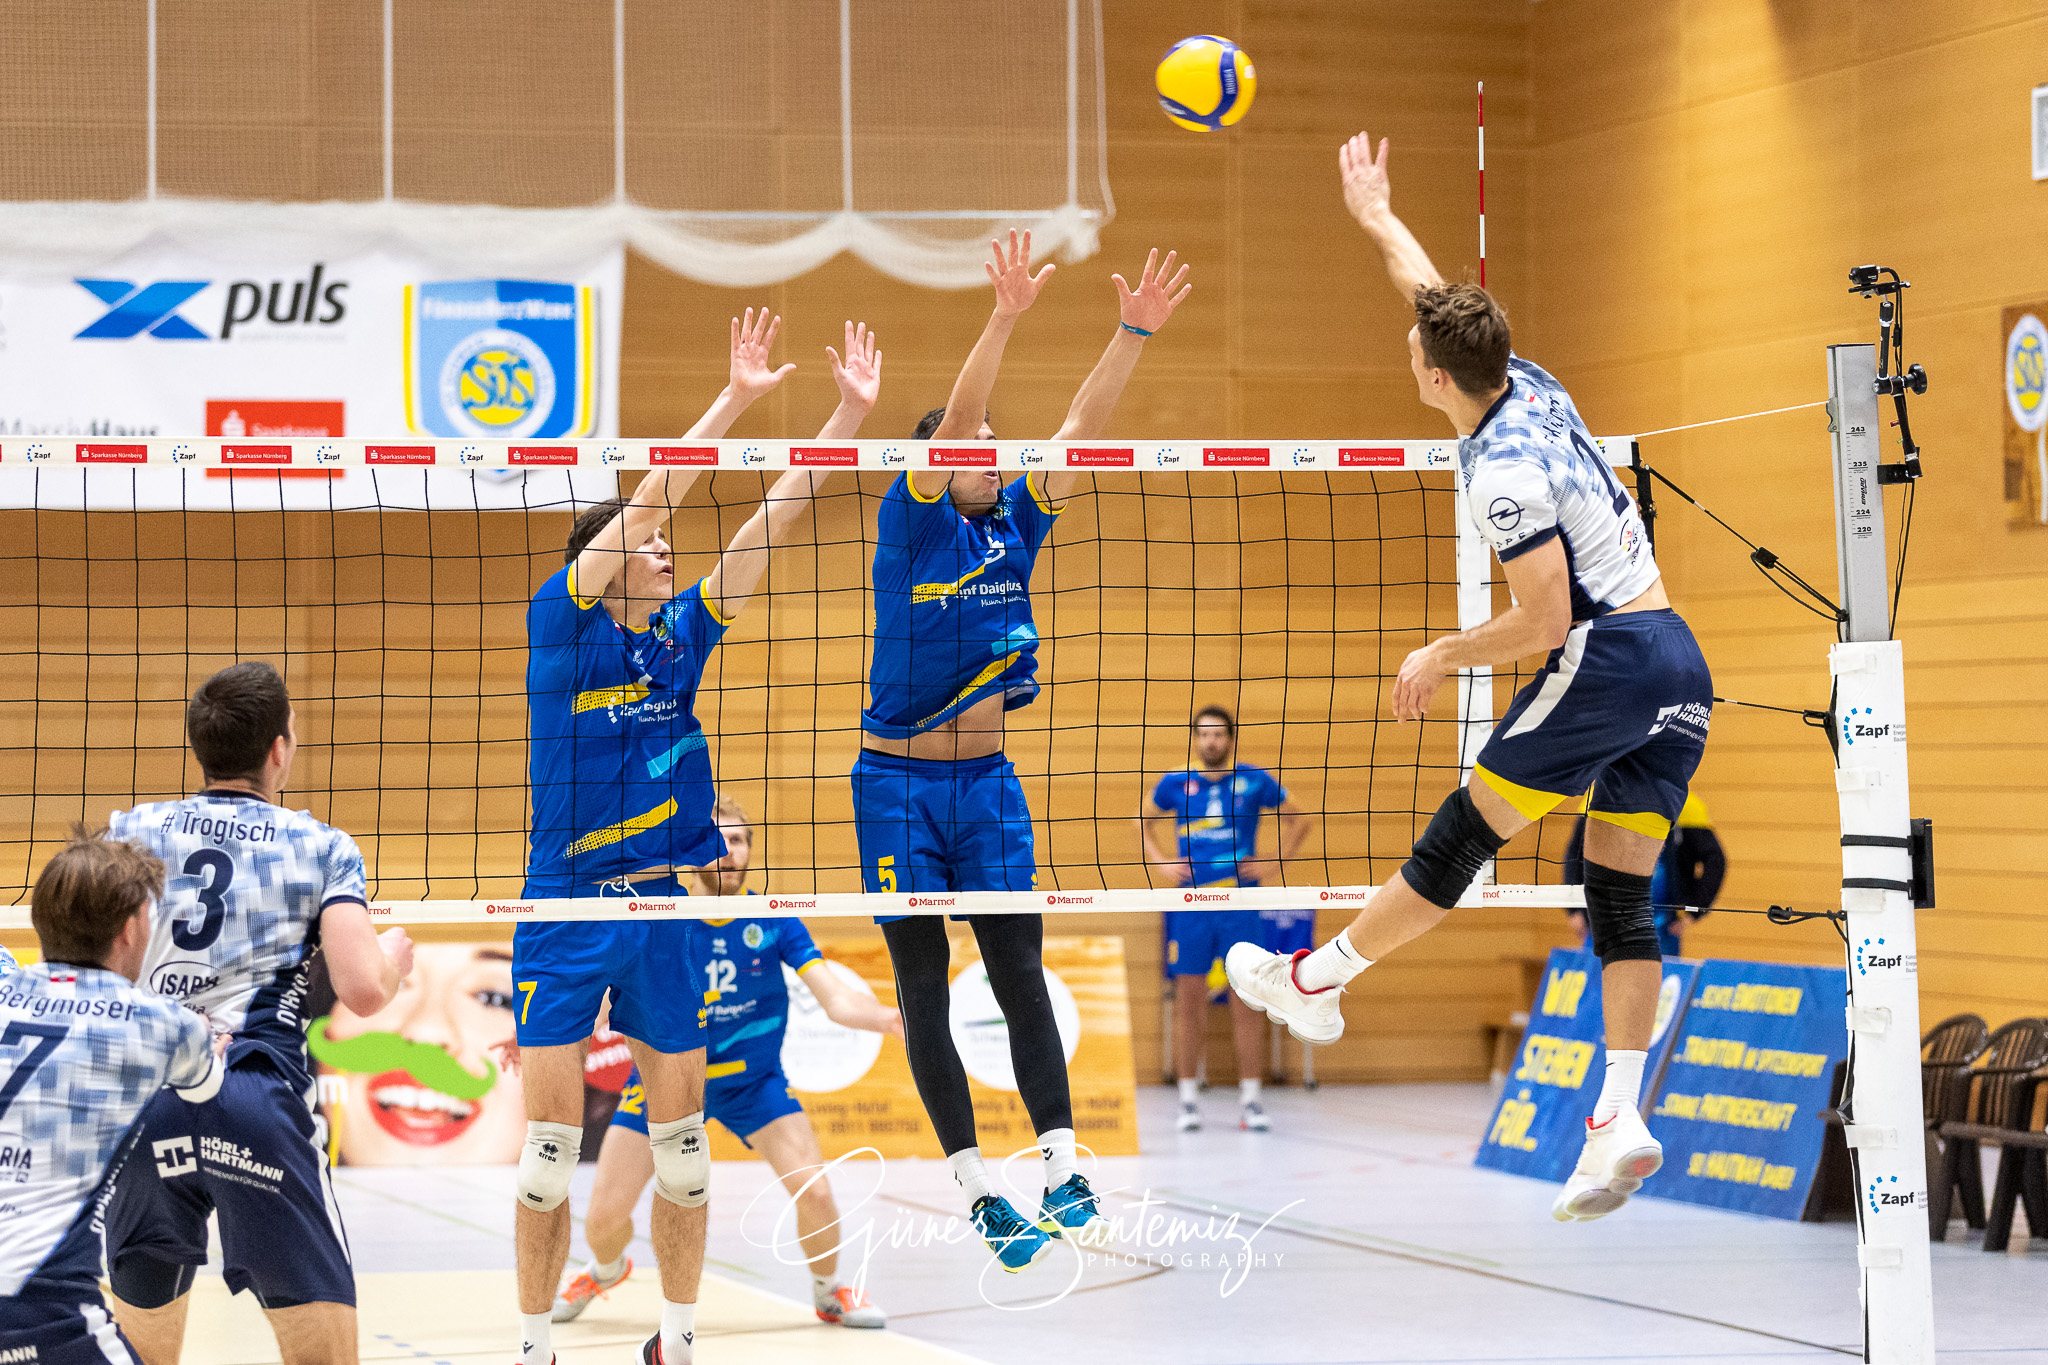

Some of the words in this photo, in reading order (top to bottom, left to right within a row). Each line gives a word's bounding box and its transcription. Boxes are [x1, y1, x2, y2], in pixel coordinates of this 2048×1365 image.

[34, 452, 51, 460] Zapf
[118, 452, 143, 460] Nürnberg
[179, 453, 196, 461] Zapf
[263, 453, 288, 461] Nürnberg
[323, 453, 340, 461] Zapf
[406, 453, 431, 461] Nürnberg
[467, 454, 484, 462] Zapf
[549, 454, 573, 462] Nürnberg
[608, 454, 625, 462] Zapf
[690, 454, 714, 462] Nürnberg
[749, 455, 765, 463] Zapf
[830, 455, 854, 463] Nürnberg
[888, 455, 905, 463] Zapf
[969, 456, 993, 464] Nürnberg
[1027, 456, 1043, 464] Zapf
[1106, 456, 1130, 464] Nürnberg
[1163, 456, 1180, 464] Zapf
[1242, 455, 1266, 463] Nürnberg
[1299, 456, 1316, 464] Zapf
[1377, 455, 1400, 463] Nürnberg
[1434, 455, 1450, 463] Zapf
[1855, 724, 1890, 739] Zapf
[878, 854, 898, 893] 5
[172, 848, 234, 951] 3
[1193, 893, 1230, 902] Marmot
[1328, 892, 1365, 900] Marmot
[780, 900, 817, 909] Marmot
[918, 898, 955, 907] Marmot
[1056, 896, 1093, 905] Marmot
[368, 906, 392, 915] rmot
[497, 905, 534, 914] Marmot
[639, 902, 676, 911] Marmot
[1868, 955, 1902, 969] Zapf
[704, 958, 738, 993] 12
[517, 980, 538, 1025] 7
[0, 1020, 70, 1121] 7
[200, 1148, 284, 1182] HARTMANN
[1881, 1191, 1915, 1206] Zapf
